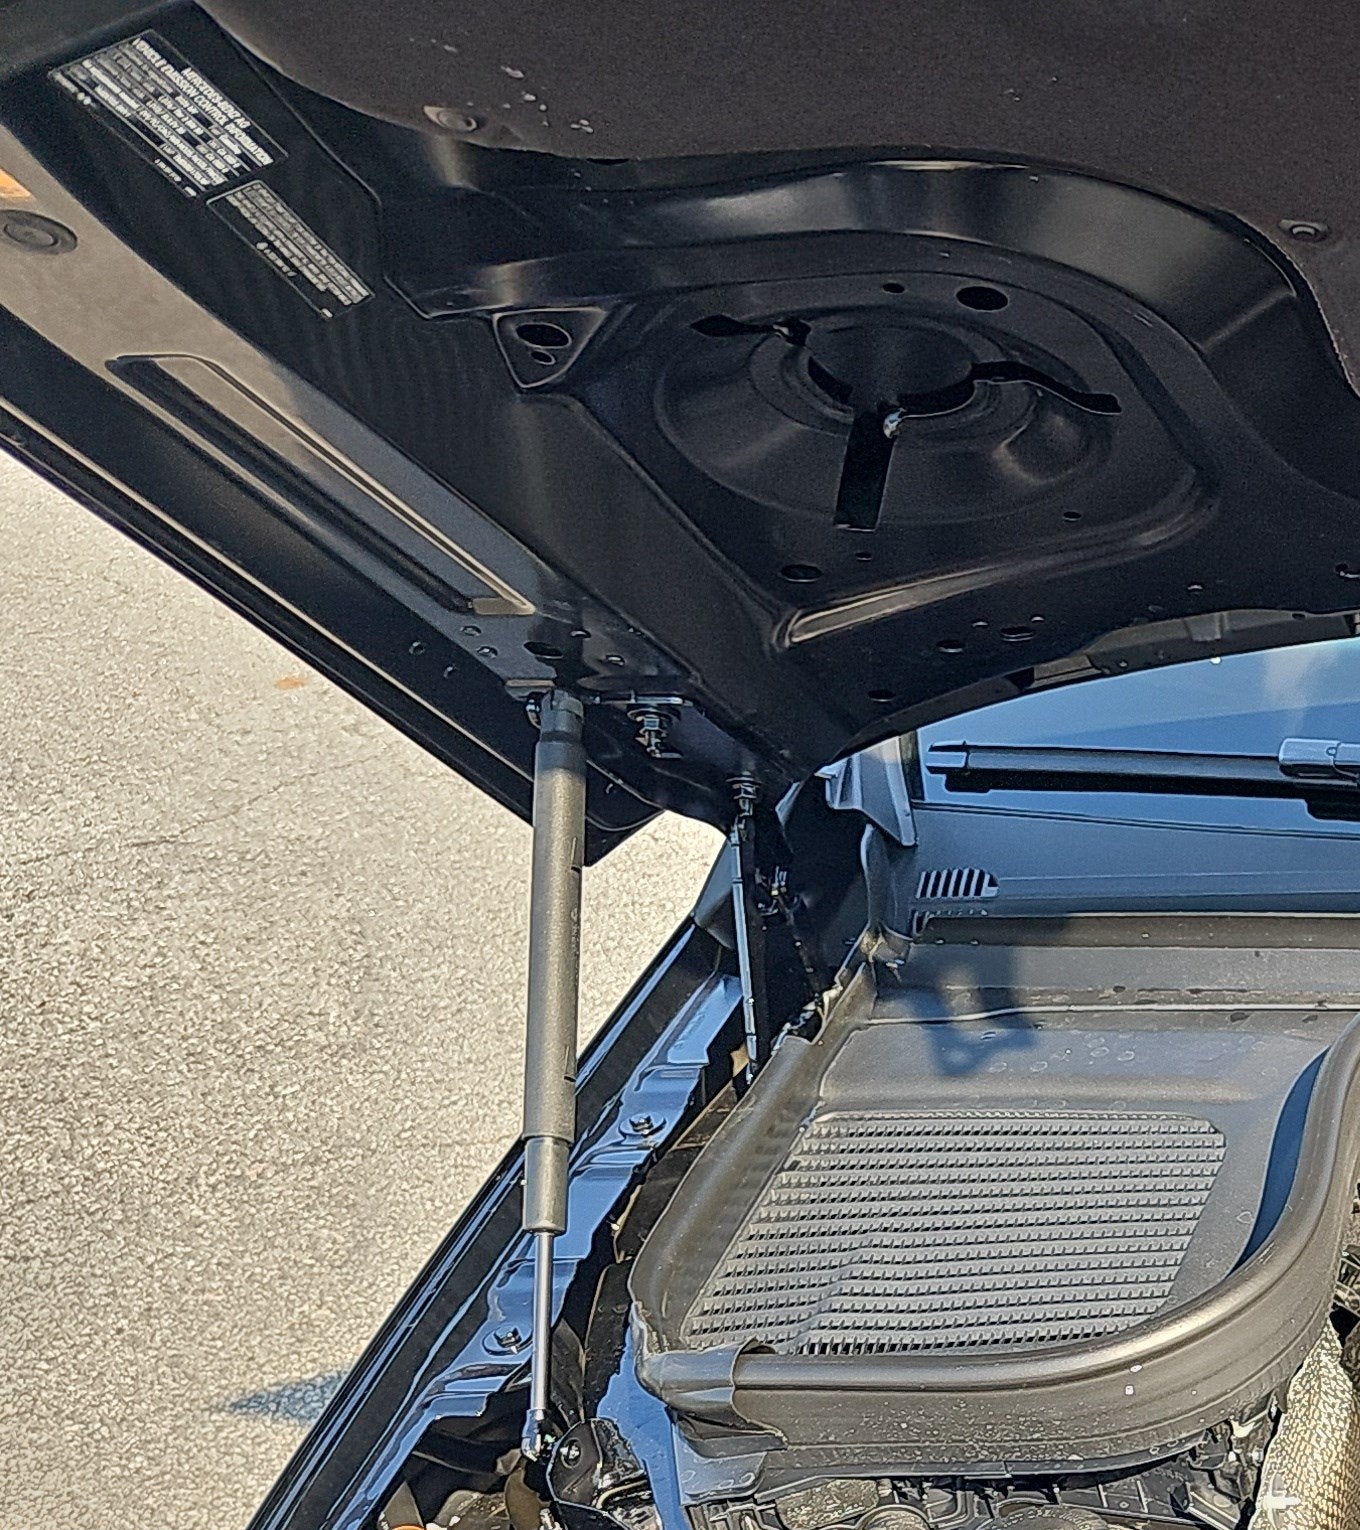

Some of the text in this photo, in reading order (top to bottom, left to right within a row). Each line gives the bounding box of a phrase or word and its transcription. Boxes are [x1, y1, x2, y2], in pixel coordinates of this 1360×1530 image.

[132, 37, 167, 65] VEHICLE
[161, 63, 198, 96] EMISSION
[194, 94, 227, 126] CONTROL
[224, 122, 274, 165] INFORMATION
[181, 67, 243, 119] MERCEDES-BENZ
